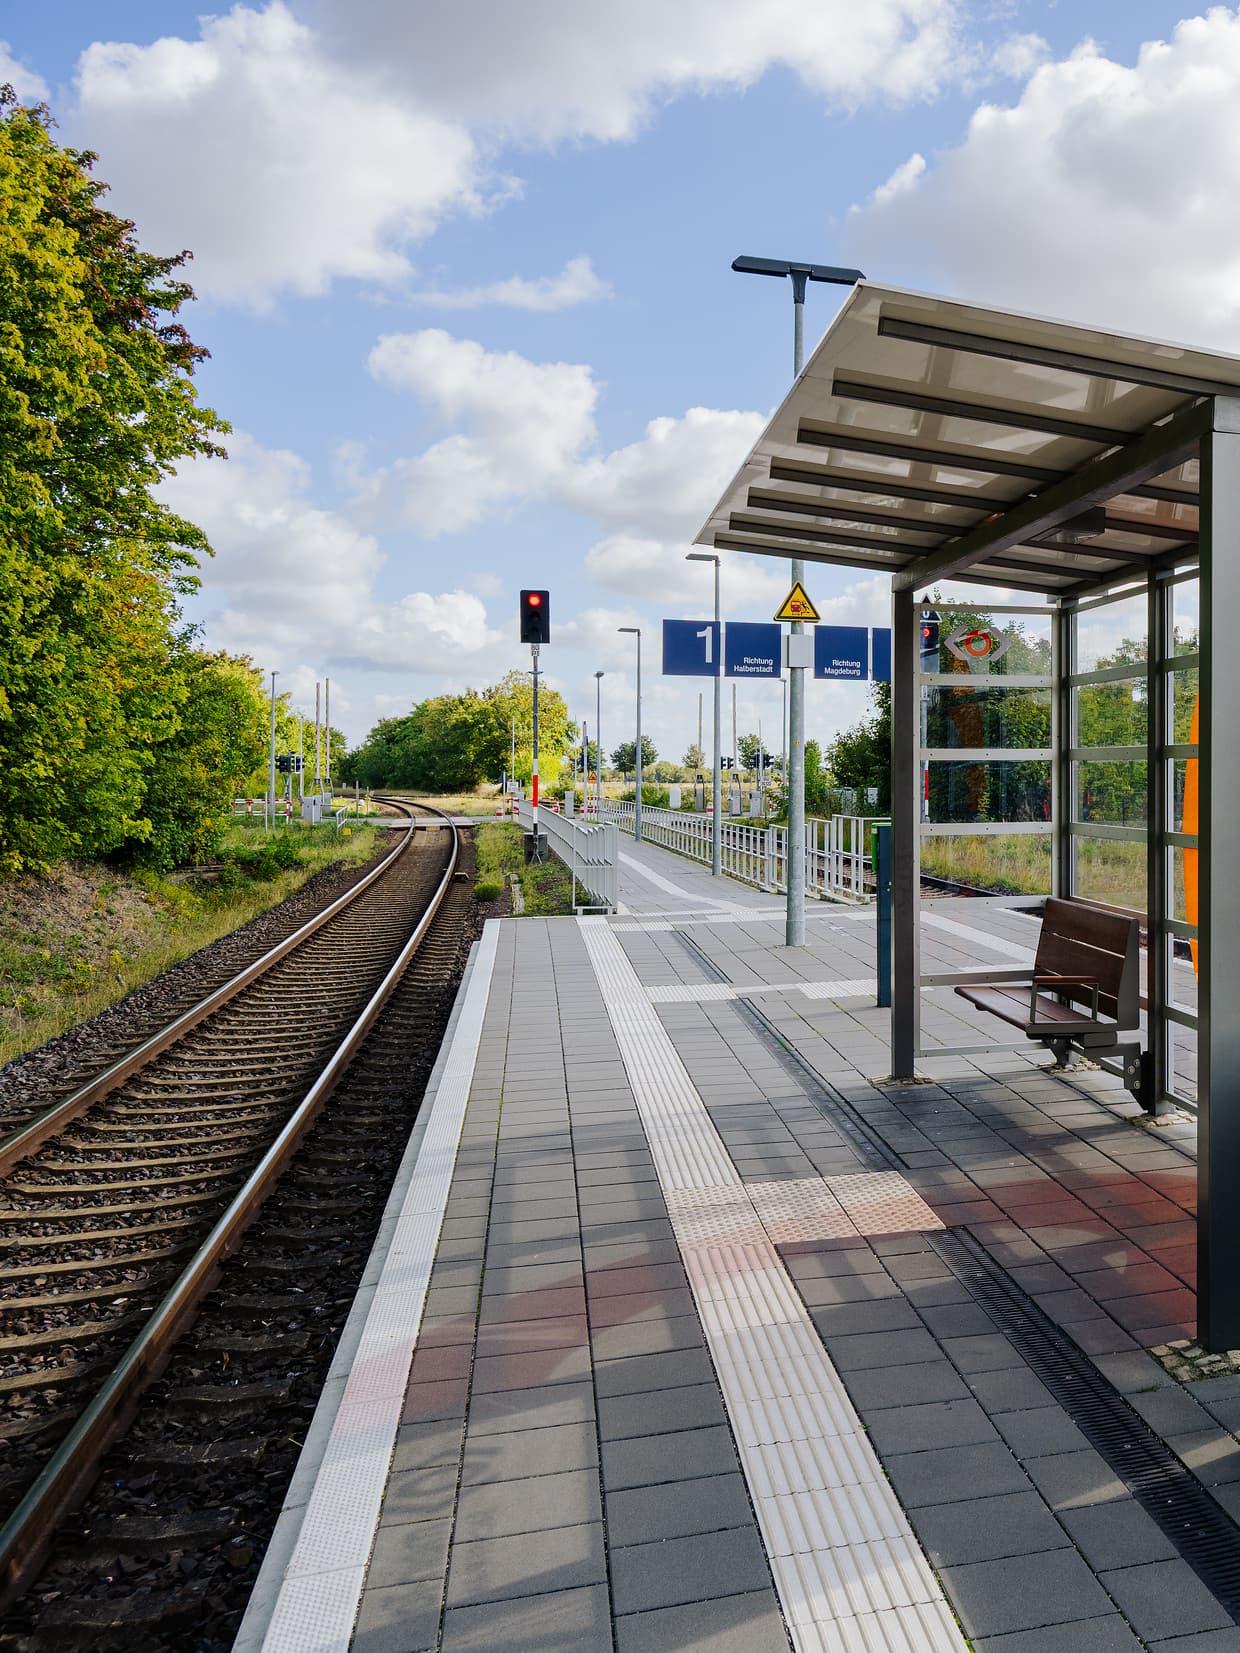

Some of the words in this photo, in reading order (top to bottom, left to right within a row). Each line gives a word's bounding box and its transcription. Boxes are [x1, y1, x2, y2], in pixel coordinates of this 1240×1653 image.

[696, 626, 713, 663] 1
[743, 656, 773, 666] Richtung
[832, 659, 861, 668] Richtung
[733, 664, 773, 673] Halberstadt
[824, 666, 861, 676] Magdeburg
